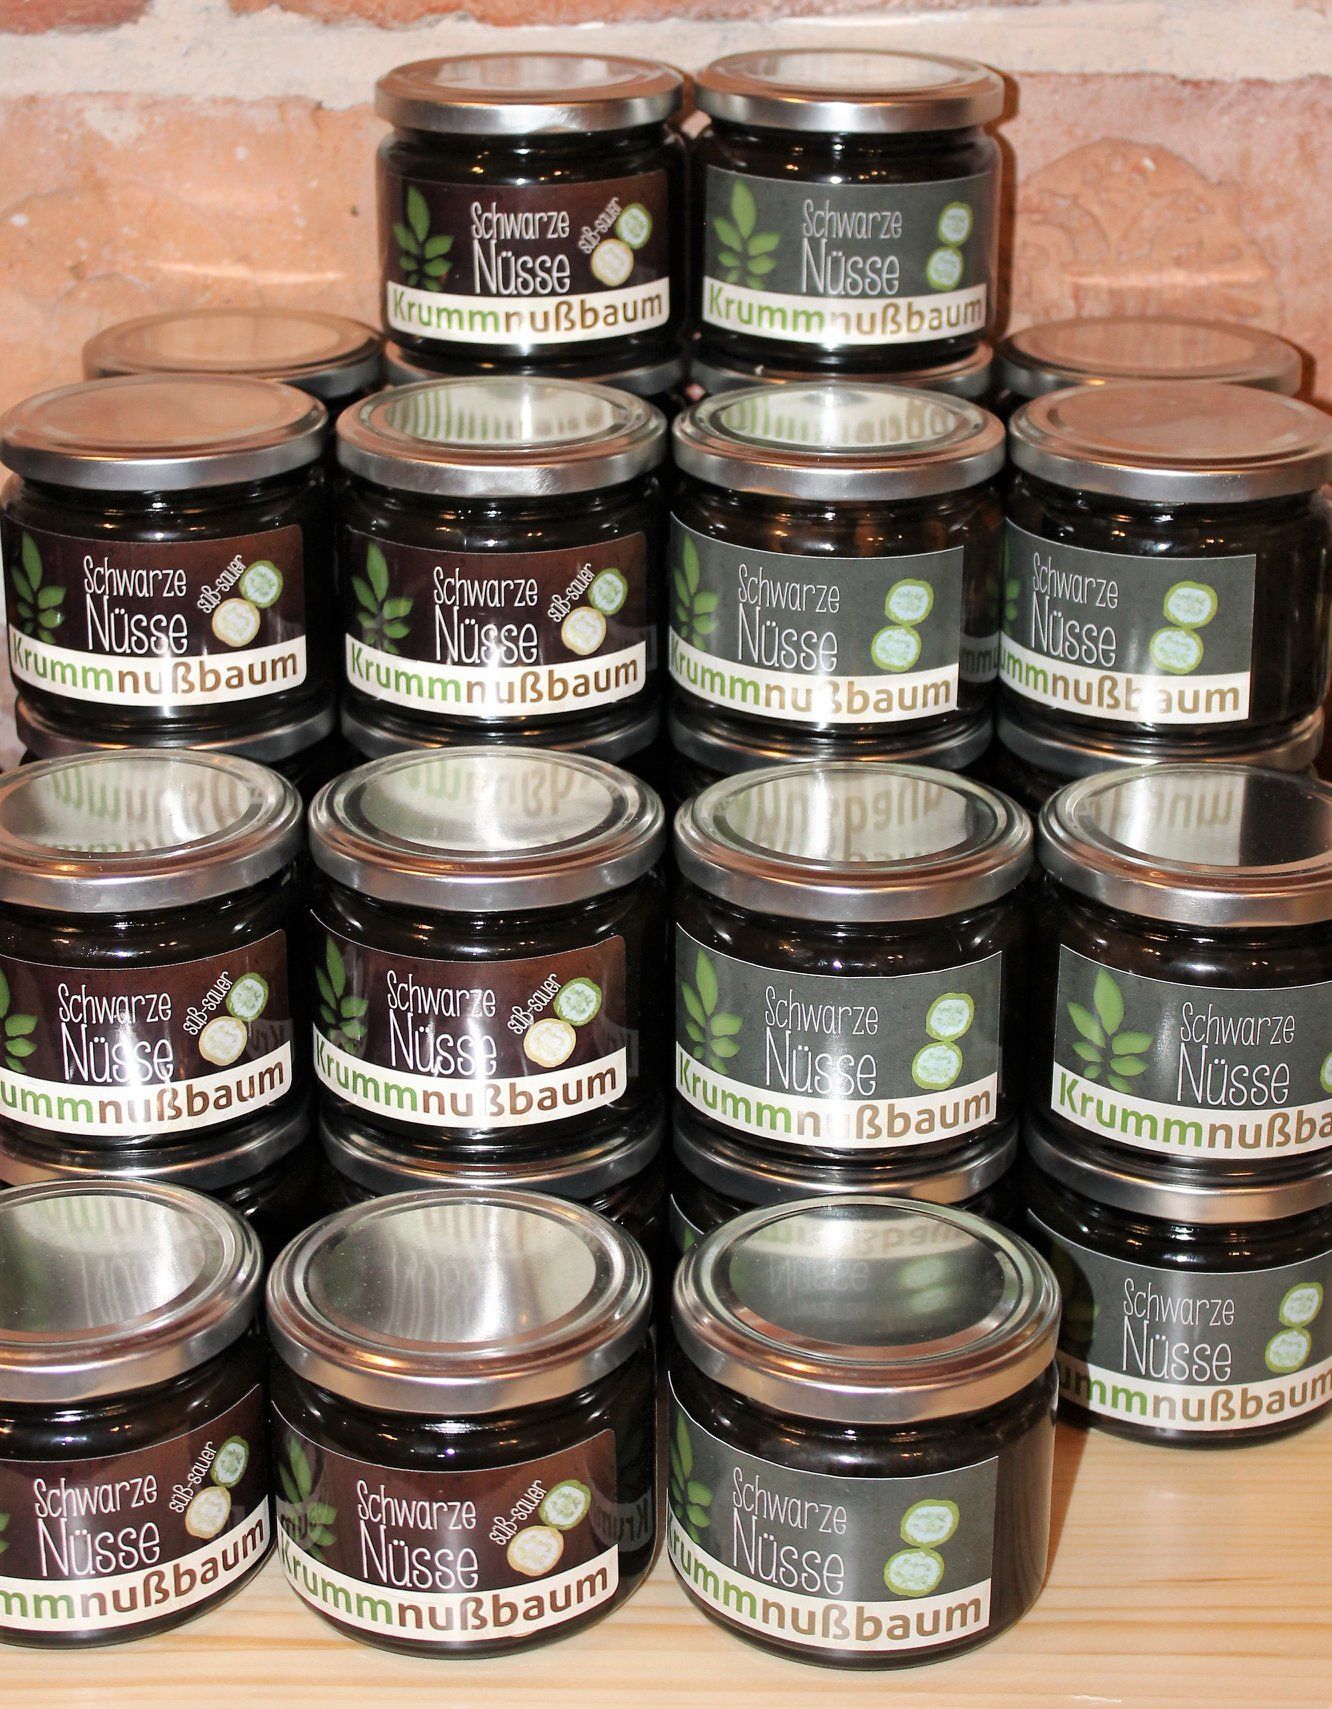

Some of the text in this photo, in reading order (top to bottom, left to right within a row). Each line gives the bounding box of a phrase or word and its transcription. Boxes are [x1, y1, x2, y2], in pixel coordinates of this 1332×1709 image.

[471, 201, 570, 239] Schwarze
[578, 197, 622, 253] süß-sauer
[802, 199, 902, 241] Schwarze
[473, 239, 571, 295] Nüsse
[801, 239, 901, 296] Nüsse
[393, 288, 662, 333] Krummnußbaum
[708, 283, 982, 335] Krummnußbaum
[83, 554, 187, 599] Schwarze
[197, 553, 247, 615] süß-sauer
[433, 566, 538, 607] Schwarze
[547, 563, 595, 623] süß-sauer
[738, 563, 840, 614] Schwarze
[1033, 551, 1118, 608] Schwarze
[86, 594, 188, 655] Nüsse
[435, 605, 538, 665] Nüsse
[738, 603, 839, 672] Nüsse
[1031, 591, 1117, 667] Nüsse
[12, 633, 298, 695] Krummnußbaum
[350, 642, 638, 704] Krummnußbaum
[58, 983, 172, 1024] Schwarze
[183, 970, 233, 1035] süß-sauer
[387, 969, 497, 1019] Schwarze
[507, 971, 561, 1035] süß-sauer
[765, 985, 878, 1035] Schwarze
[1180, 1001, 1295, 1046] Schwarze
[62, 1019, 174, 1082] Nüsse
[388, 1013, 497, 1077] Nüsse
[765, 1029, 877, 1095] Nüsse
[1177, 1042, 1290, 1106] Nüsse
[316, 1034, 617, 1117] Krummnußbaum
[1124, 1278, 1235, 1326] Schwarze
[1121, 1316, 1232, 1382] Nüsse
[33, 1473, 157, 1519] Schwarze
[169, 1441, 217, 1514] süß-sauer
[357, 1480, 476, 1530] Schwarze
[732, 1466, 847, 1535] Schwarze
[489, 1478, 547, 1546] süß-sauer
[37, 1517, 161, 1577] Nüsse
[360, 1519, 480, 1589] Nüsse
[732, 1506, 845, 1596] Nüsse
[281, 1531, 609, 1631] Krummnußbaum
